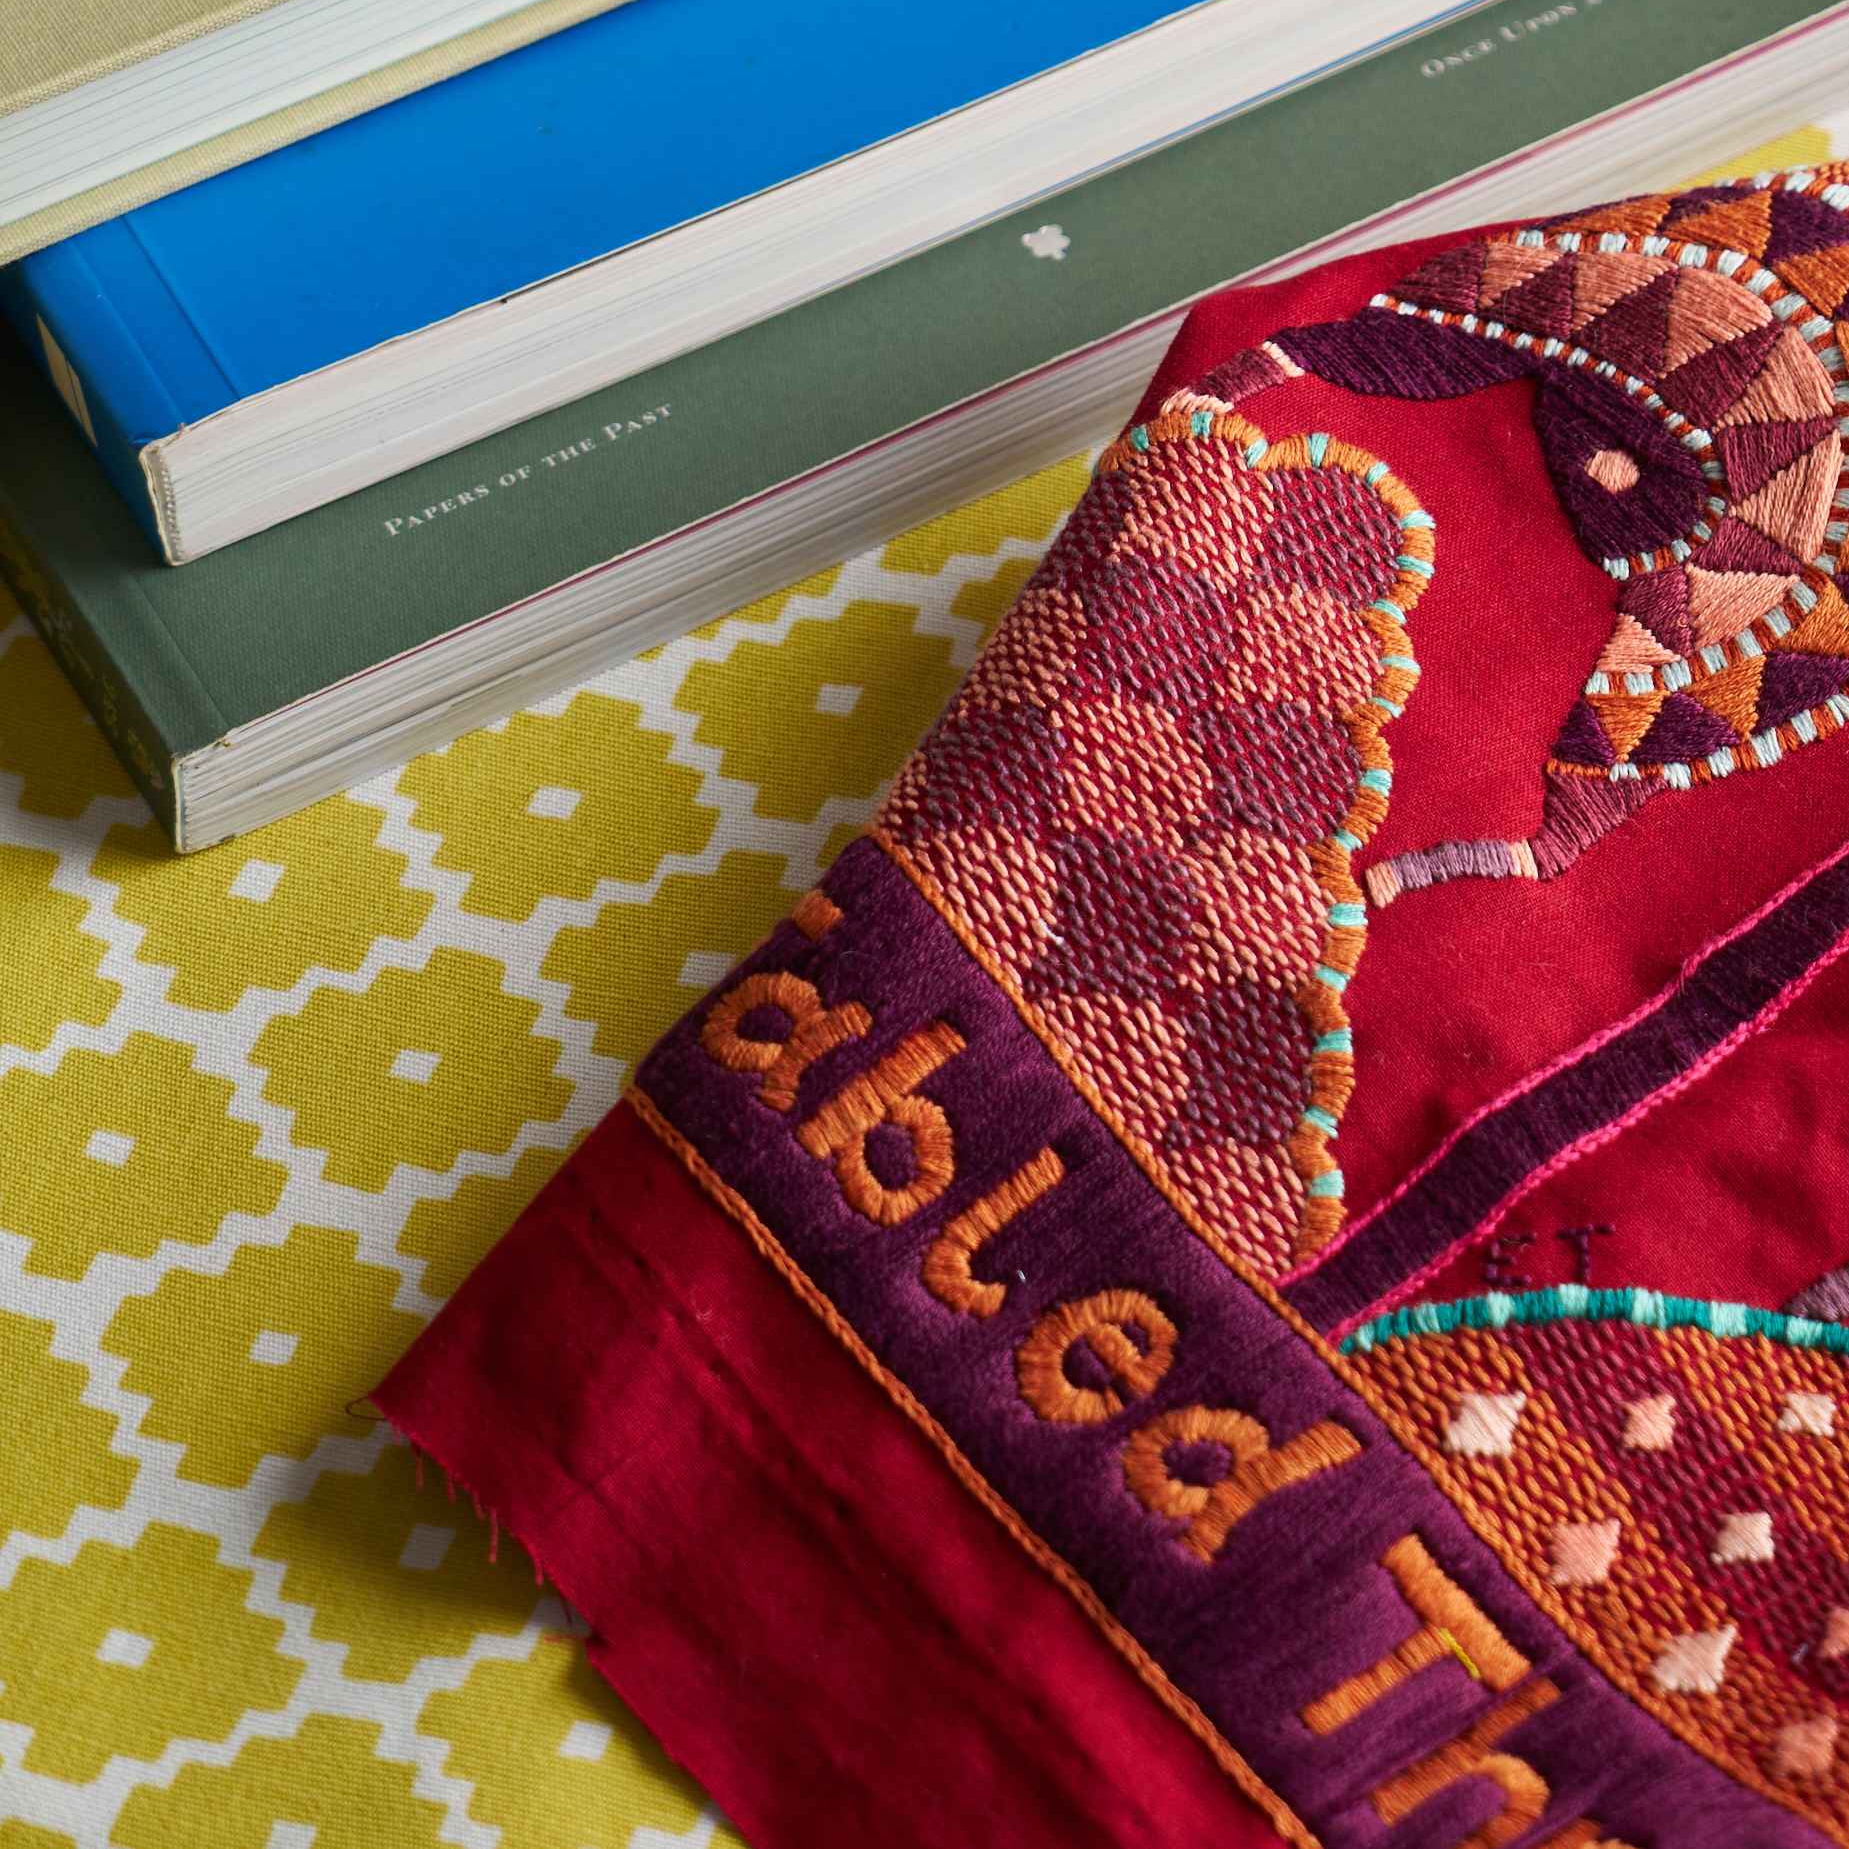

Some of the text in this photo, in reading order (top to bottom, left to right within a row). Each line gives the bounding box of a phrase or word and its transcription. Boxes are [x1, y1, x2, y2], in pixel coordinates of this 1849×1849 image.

[383, 481, 490, 538] PAPERS
[602, 401, 675, 443] PAST
[700, 891, 1612, 1849] abled Th
